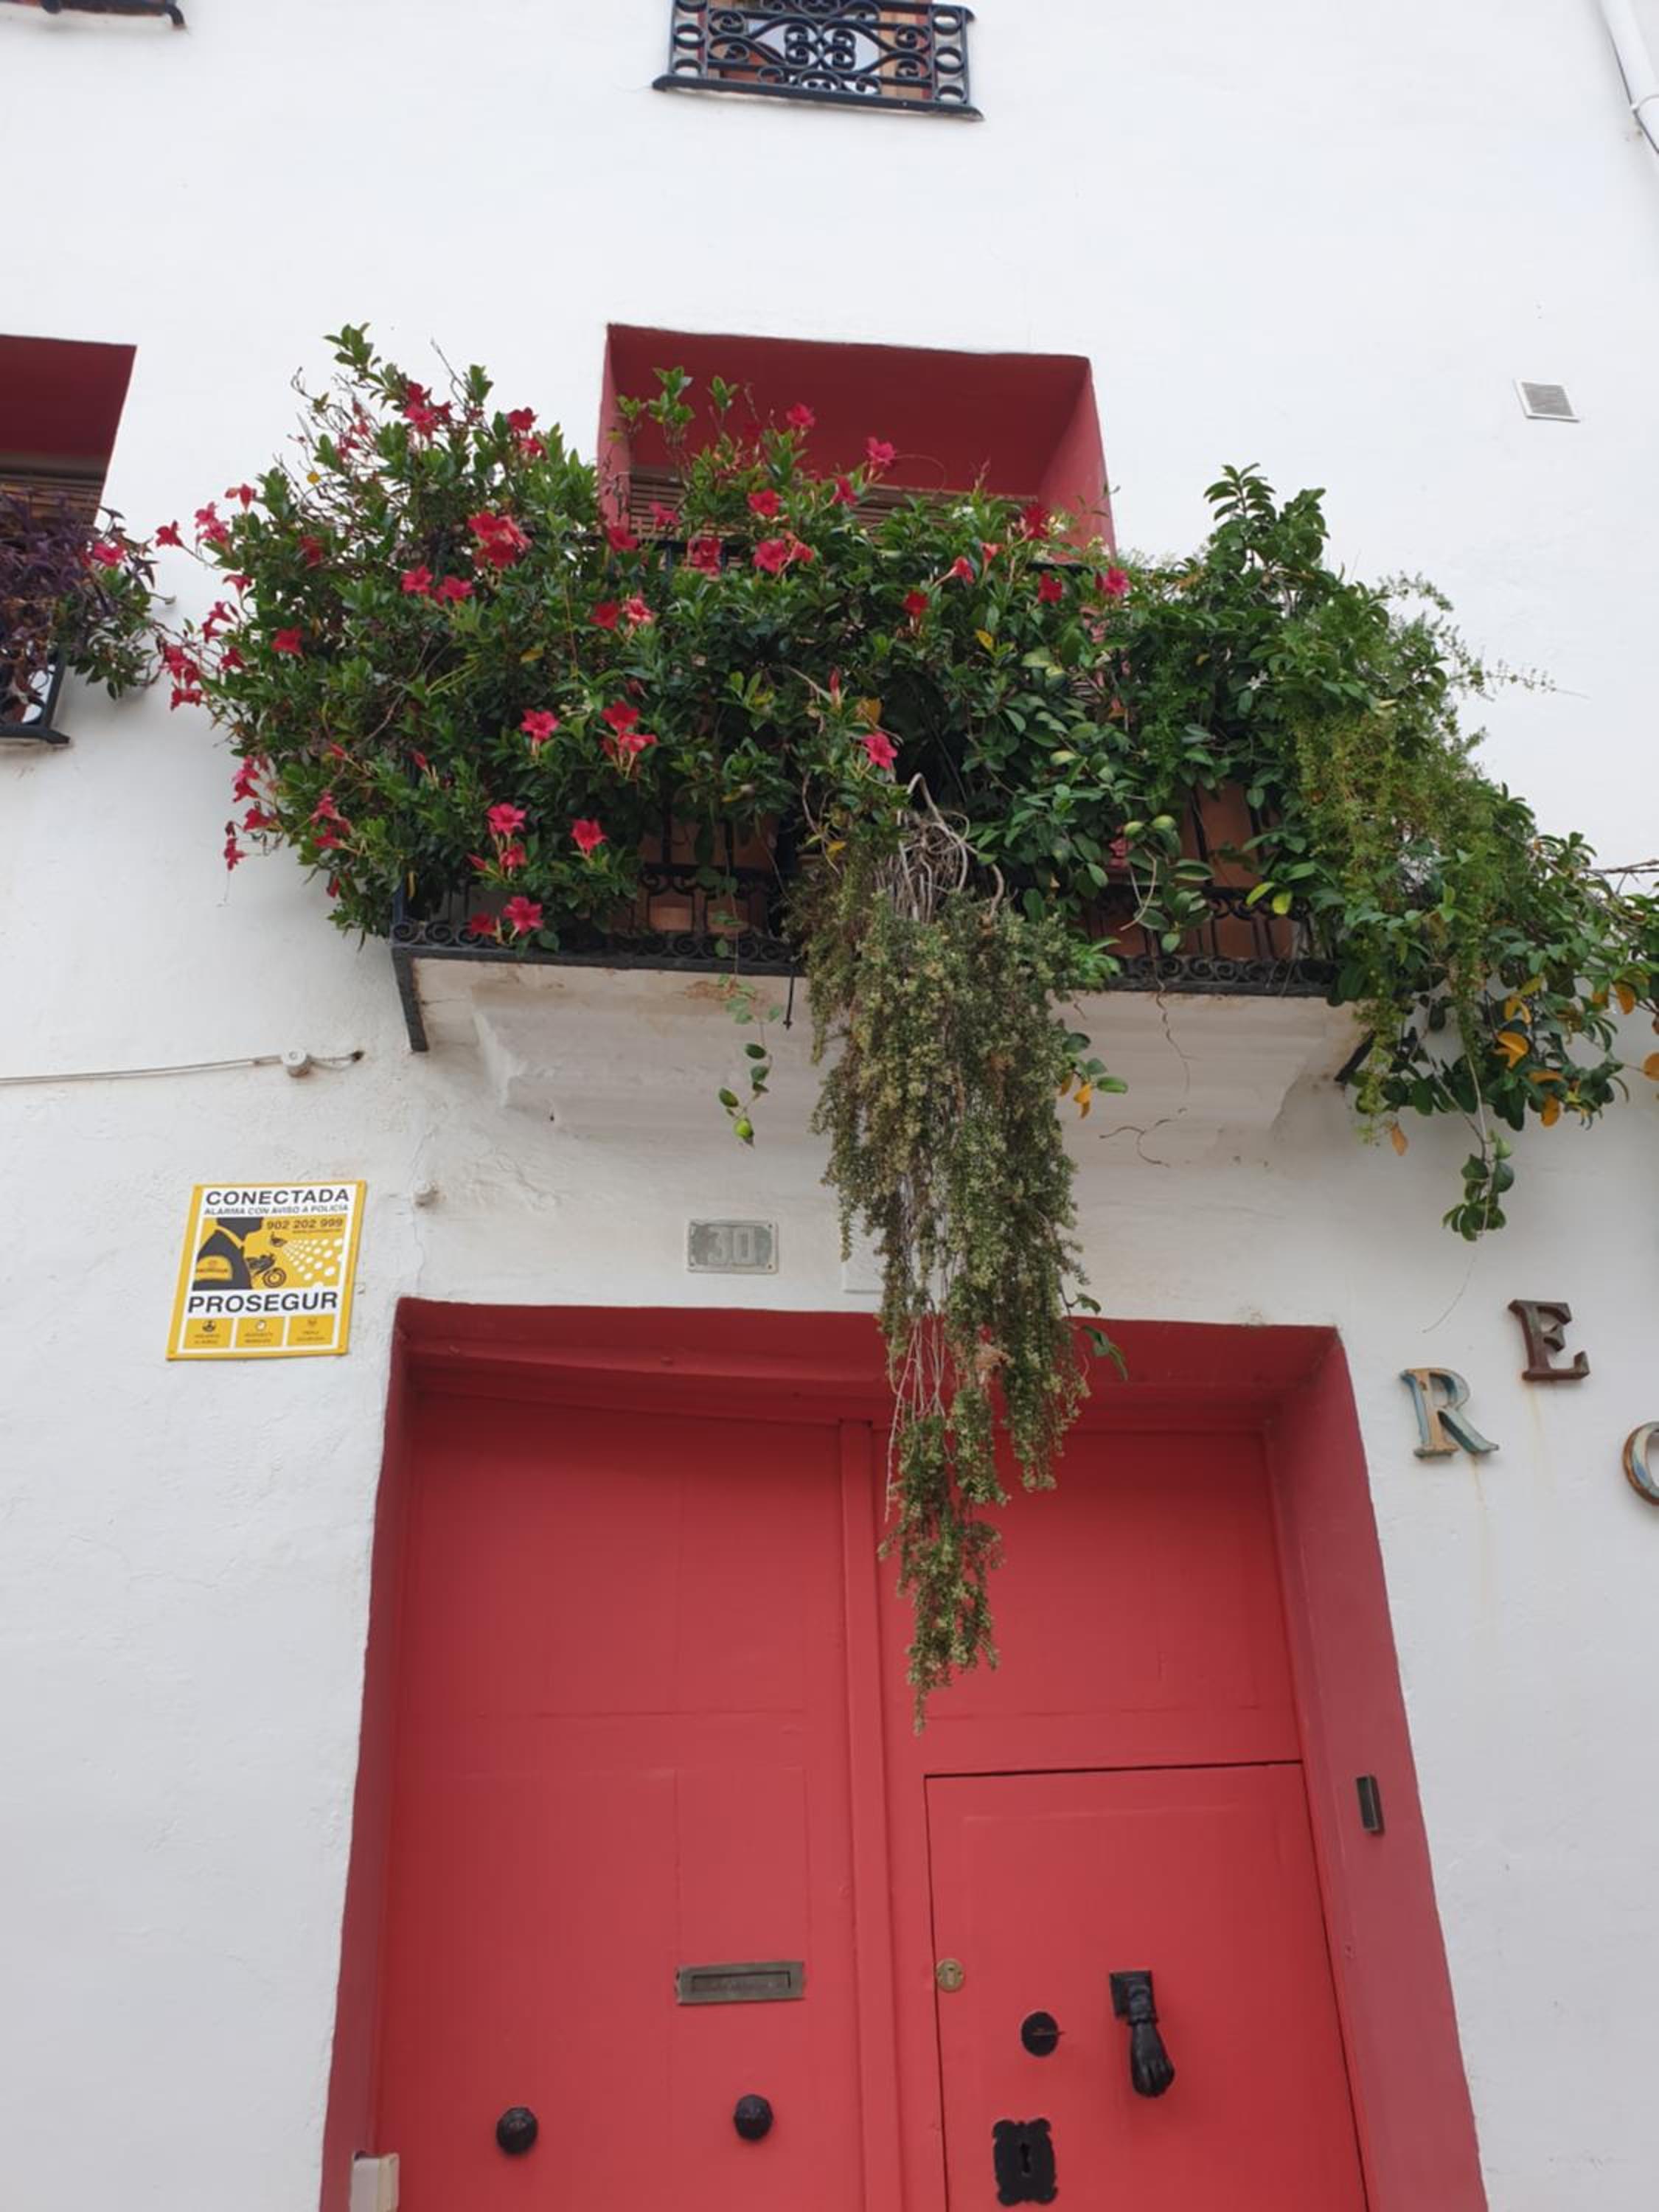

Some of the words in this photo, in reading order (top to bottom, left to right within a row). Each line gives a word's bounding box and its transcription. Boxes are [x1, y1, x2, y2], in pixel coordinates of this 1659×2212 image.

[206, 1188, 349, 1206] CONECTADA
[204, 1207, 245, 1216] ALARMA
[248, 1206, 269, 1215] CON
[271, 1206, 299, 1214] AVISO
[300, 1206, 309, 1214] A
[266, 1220, 291, 1230] 902
[293, 1220, 316, 1229] 202
[707, 1226, 755, 1264] 30
[187, 1291, 338, 1313] PROSEGUR
